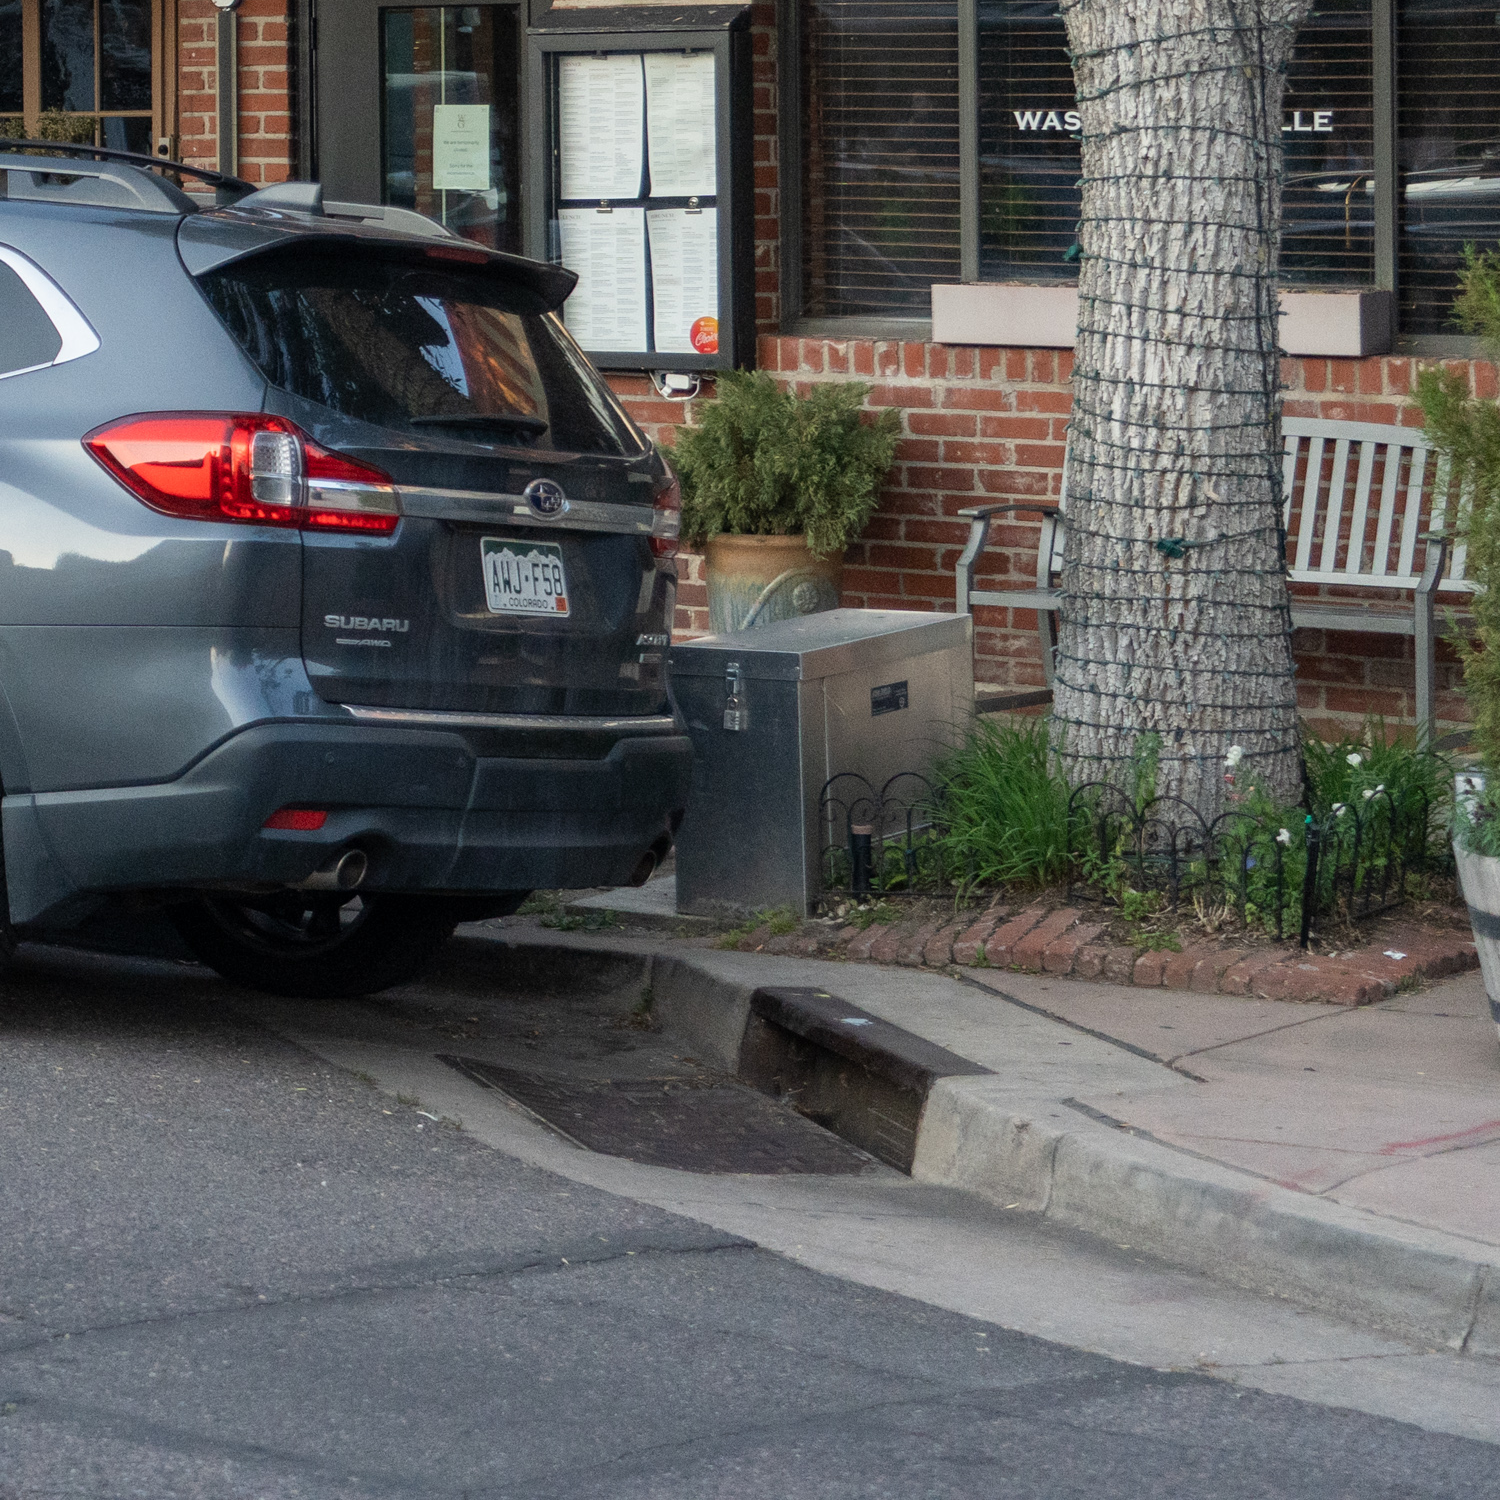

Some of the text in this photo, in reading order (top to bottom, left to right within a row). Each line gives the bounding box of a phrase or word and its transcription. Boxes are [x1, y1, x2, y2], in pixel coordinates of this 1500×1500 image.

[1013, 111, 1082, 131] WAS
[508, 597, 549, 609] COLORADO
[323, 614, 410, 633] SUBARU
[359, 638, 392, 648] AWD
